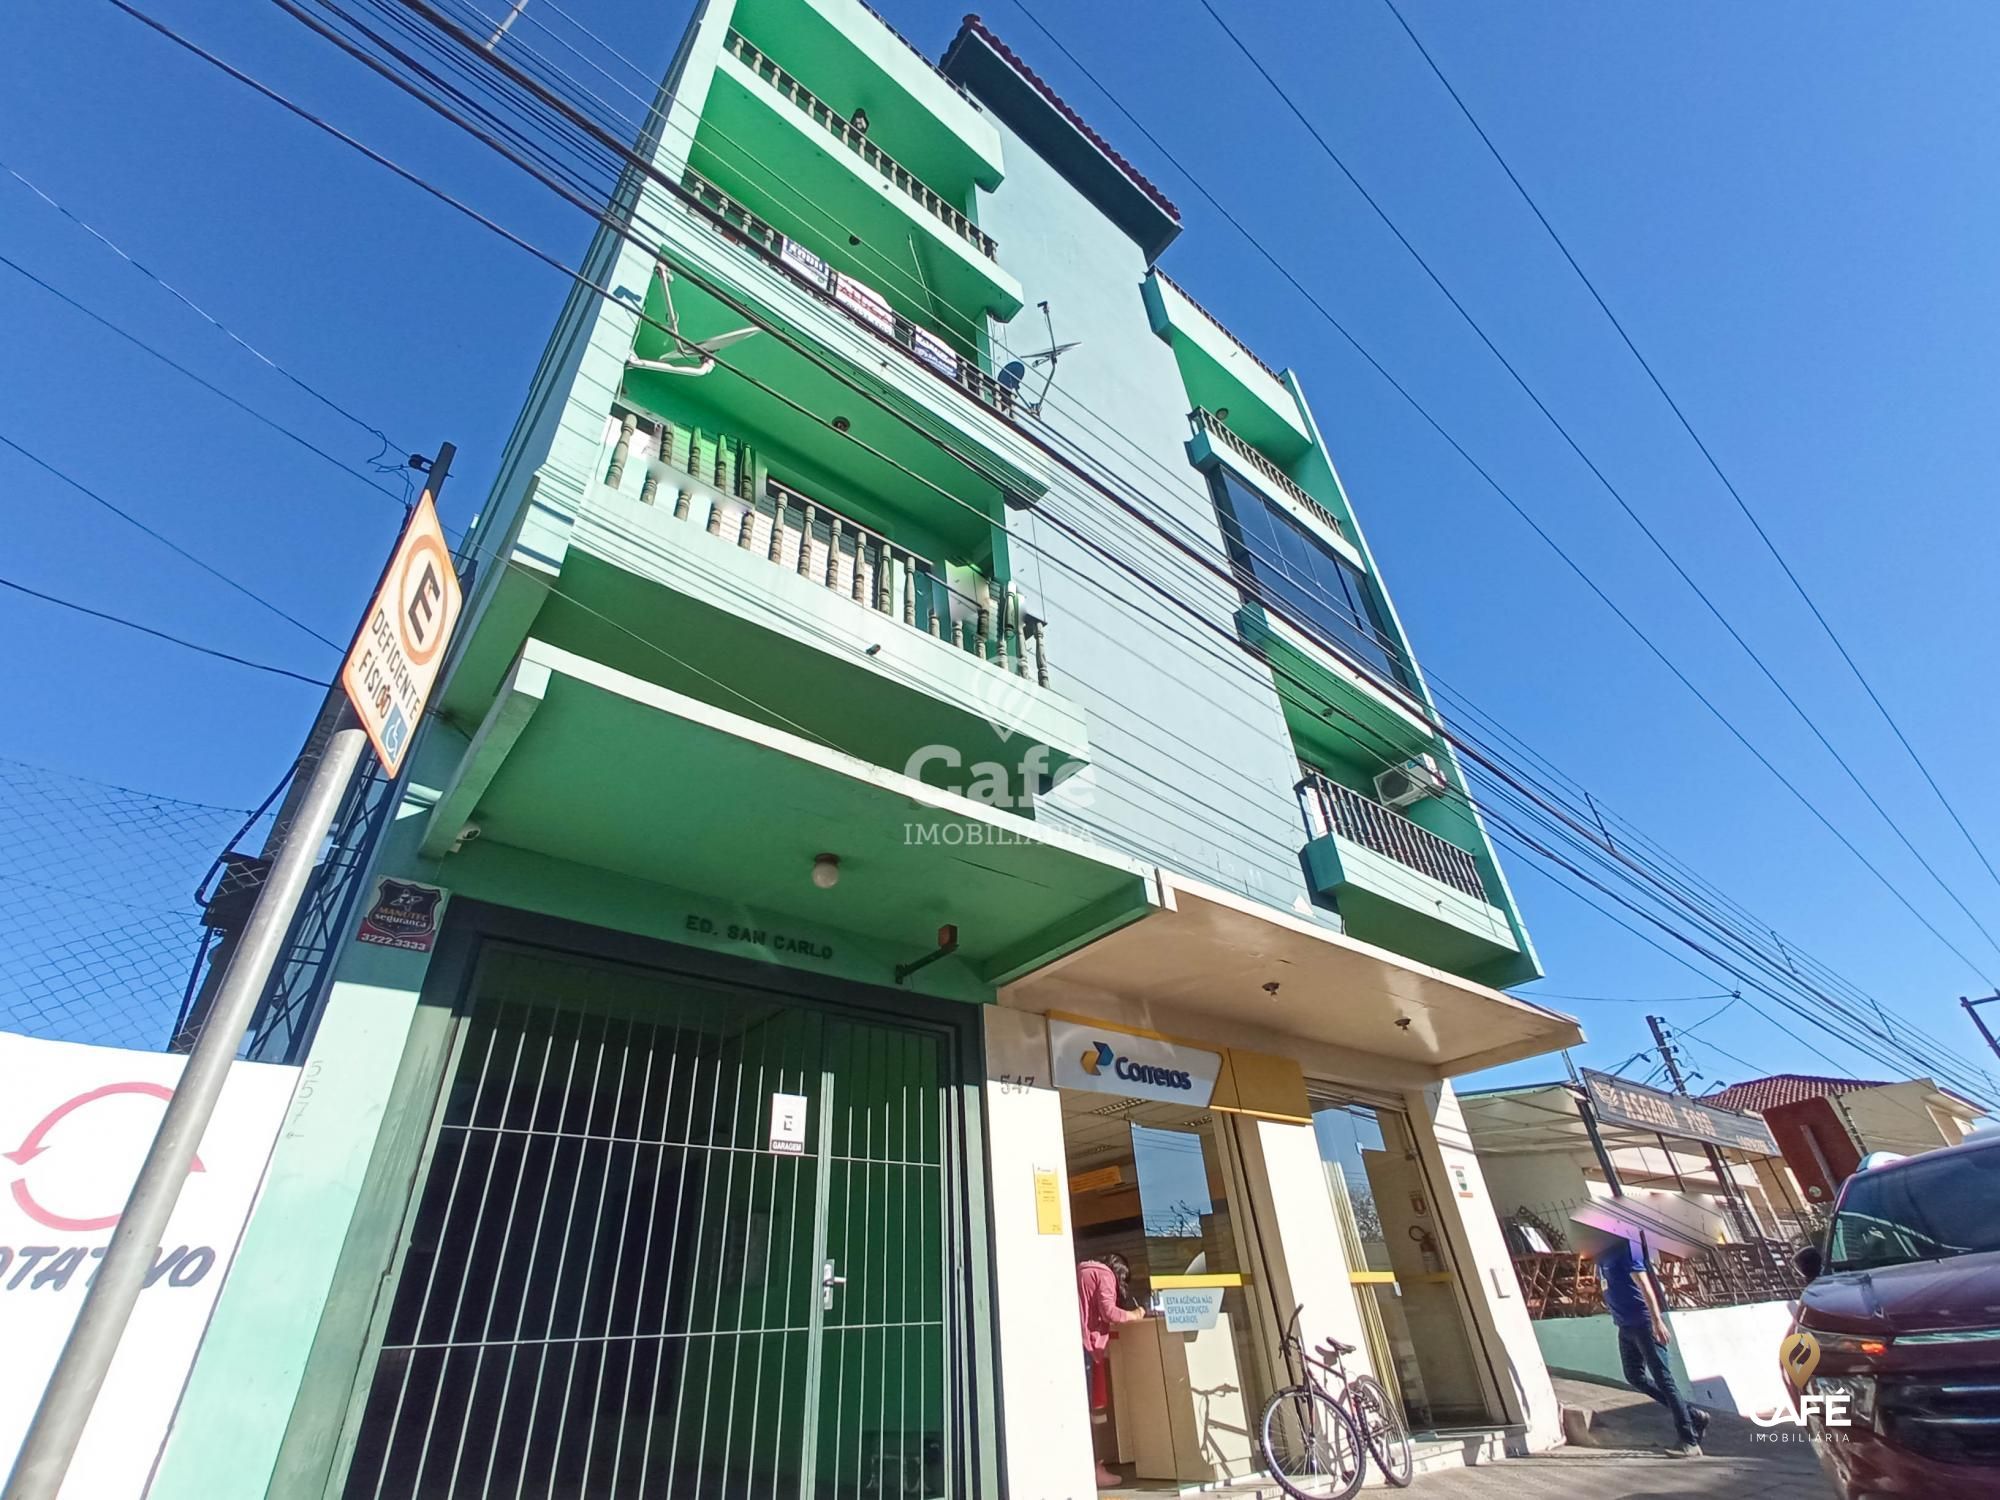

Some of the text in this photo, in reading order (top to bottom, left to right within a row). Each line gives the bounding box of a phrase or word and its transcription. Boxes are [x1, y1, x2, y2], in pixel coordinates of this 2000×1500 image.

[408, 560, 441, 645] E
[371, 607, 421, 721] DEFICIENTE
[358, 647, 392, 720] FÍSICO
[380, 906, 429, 920] MANUTEC
[360, 932, 427, 951] 3222.3333
[685, 914, 833, 961] ED. SAN CARLO
[999, 1074, 1035, 1095] 547
[1115, 1056, 1192, 1091] Correios
[772, 1140, 803, 1153] GARAGEM
[1166, 1296, 1179, 1305] ESTA
